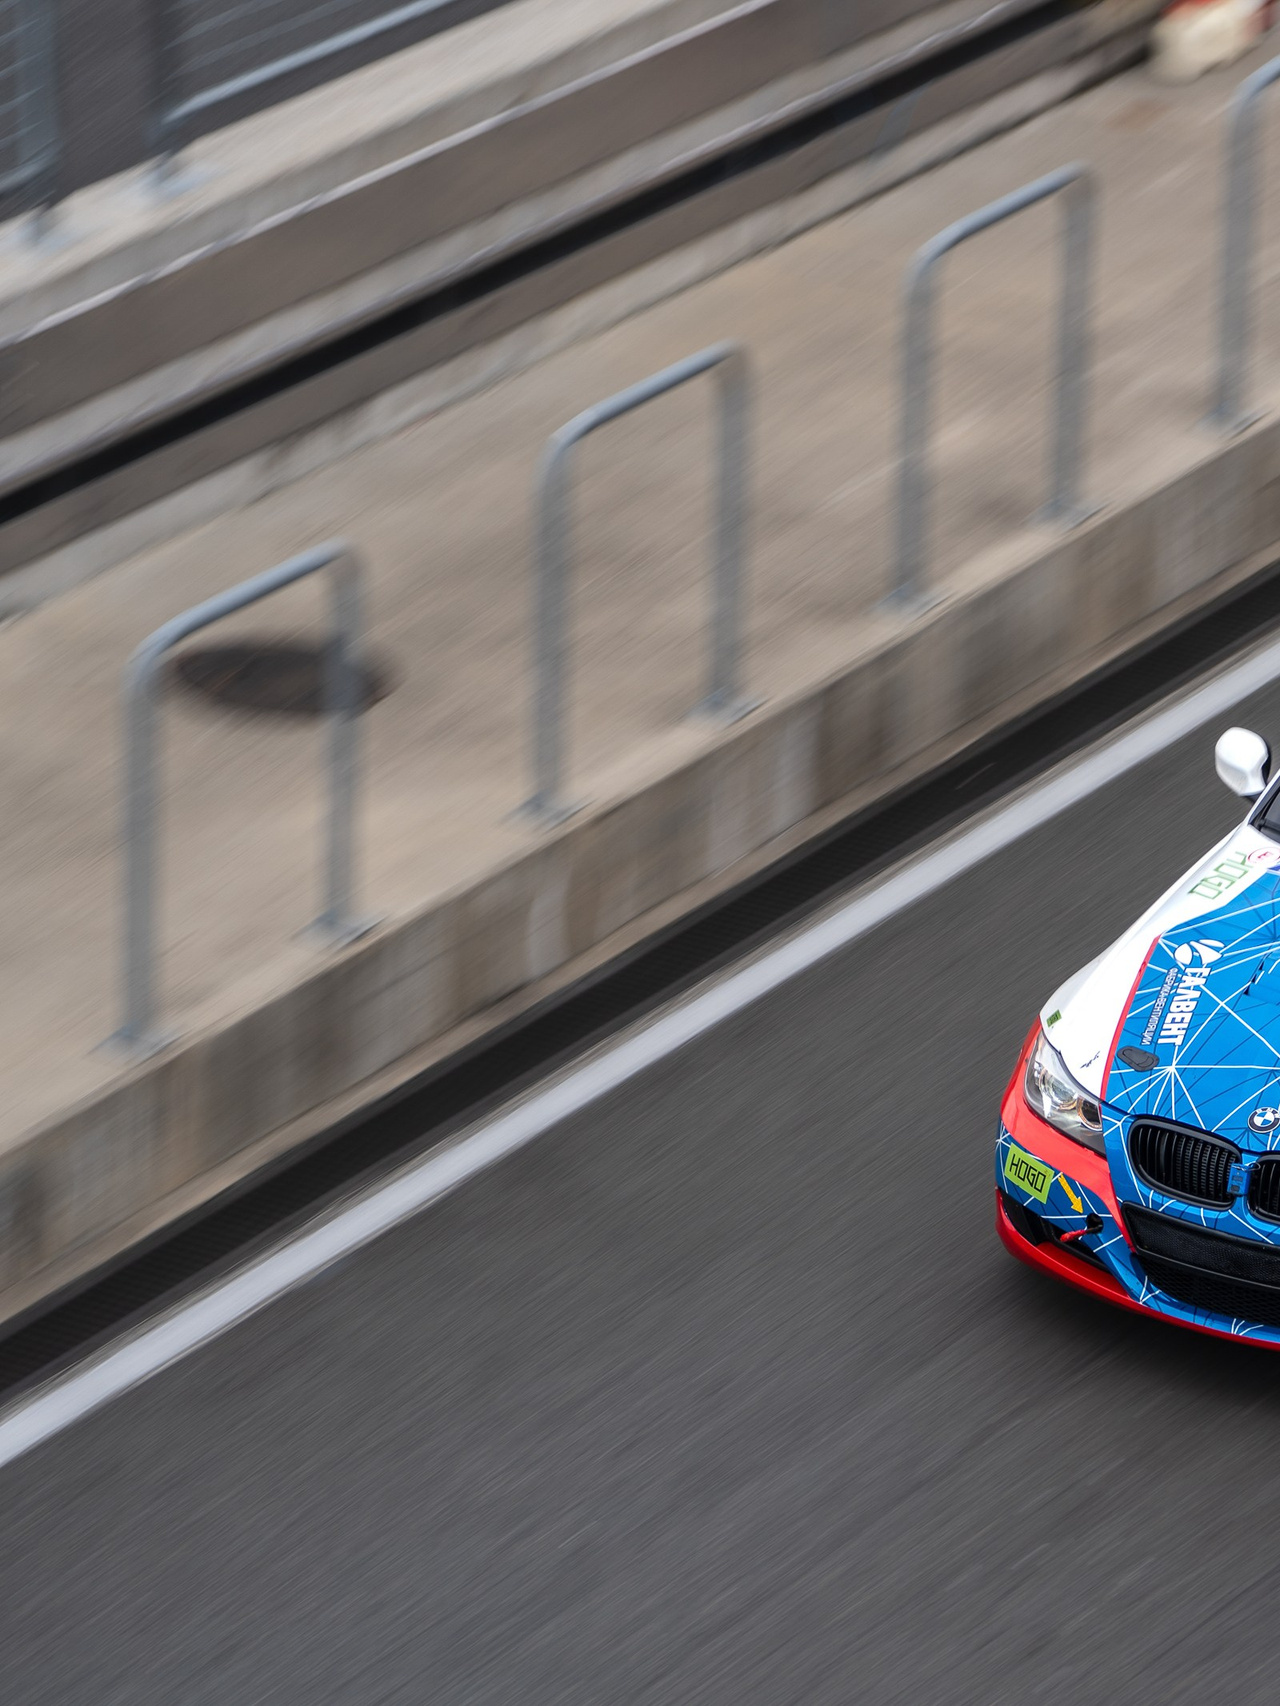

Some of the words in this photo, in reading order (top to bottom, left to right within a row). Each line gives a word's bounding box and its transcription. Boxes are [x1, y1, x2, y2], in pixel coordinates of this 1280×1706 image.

[1188, 851, 1253, 900] HOGO
[1157, 967, 1211, 1046] ГАЛВЕНТ
[1009, 1153, 1047, 1193] HOGO
